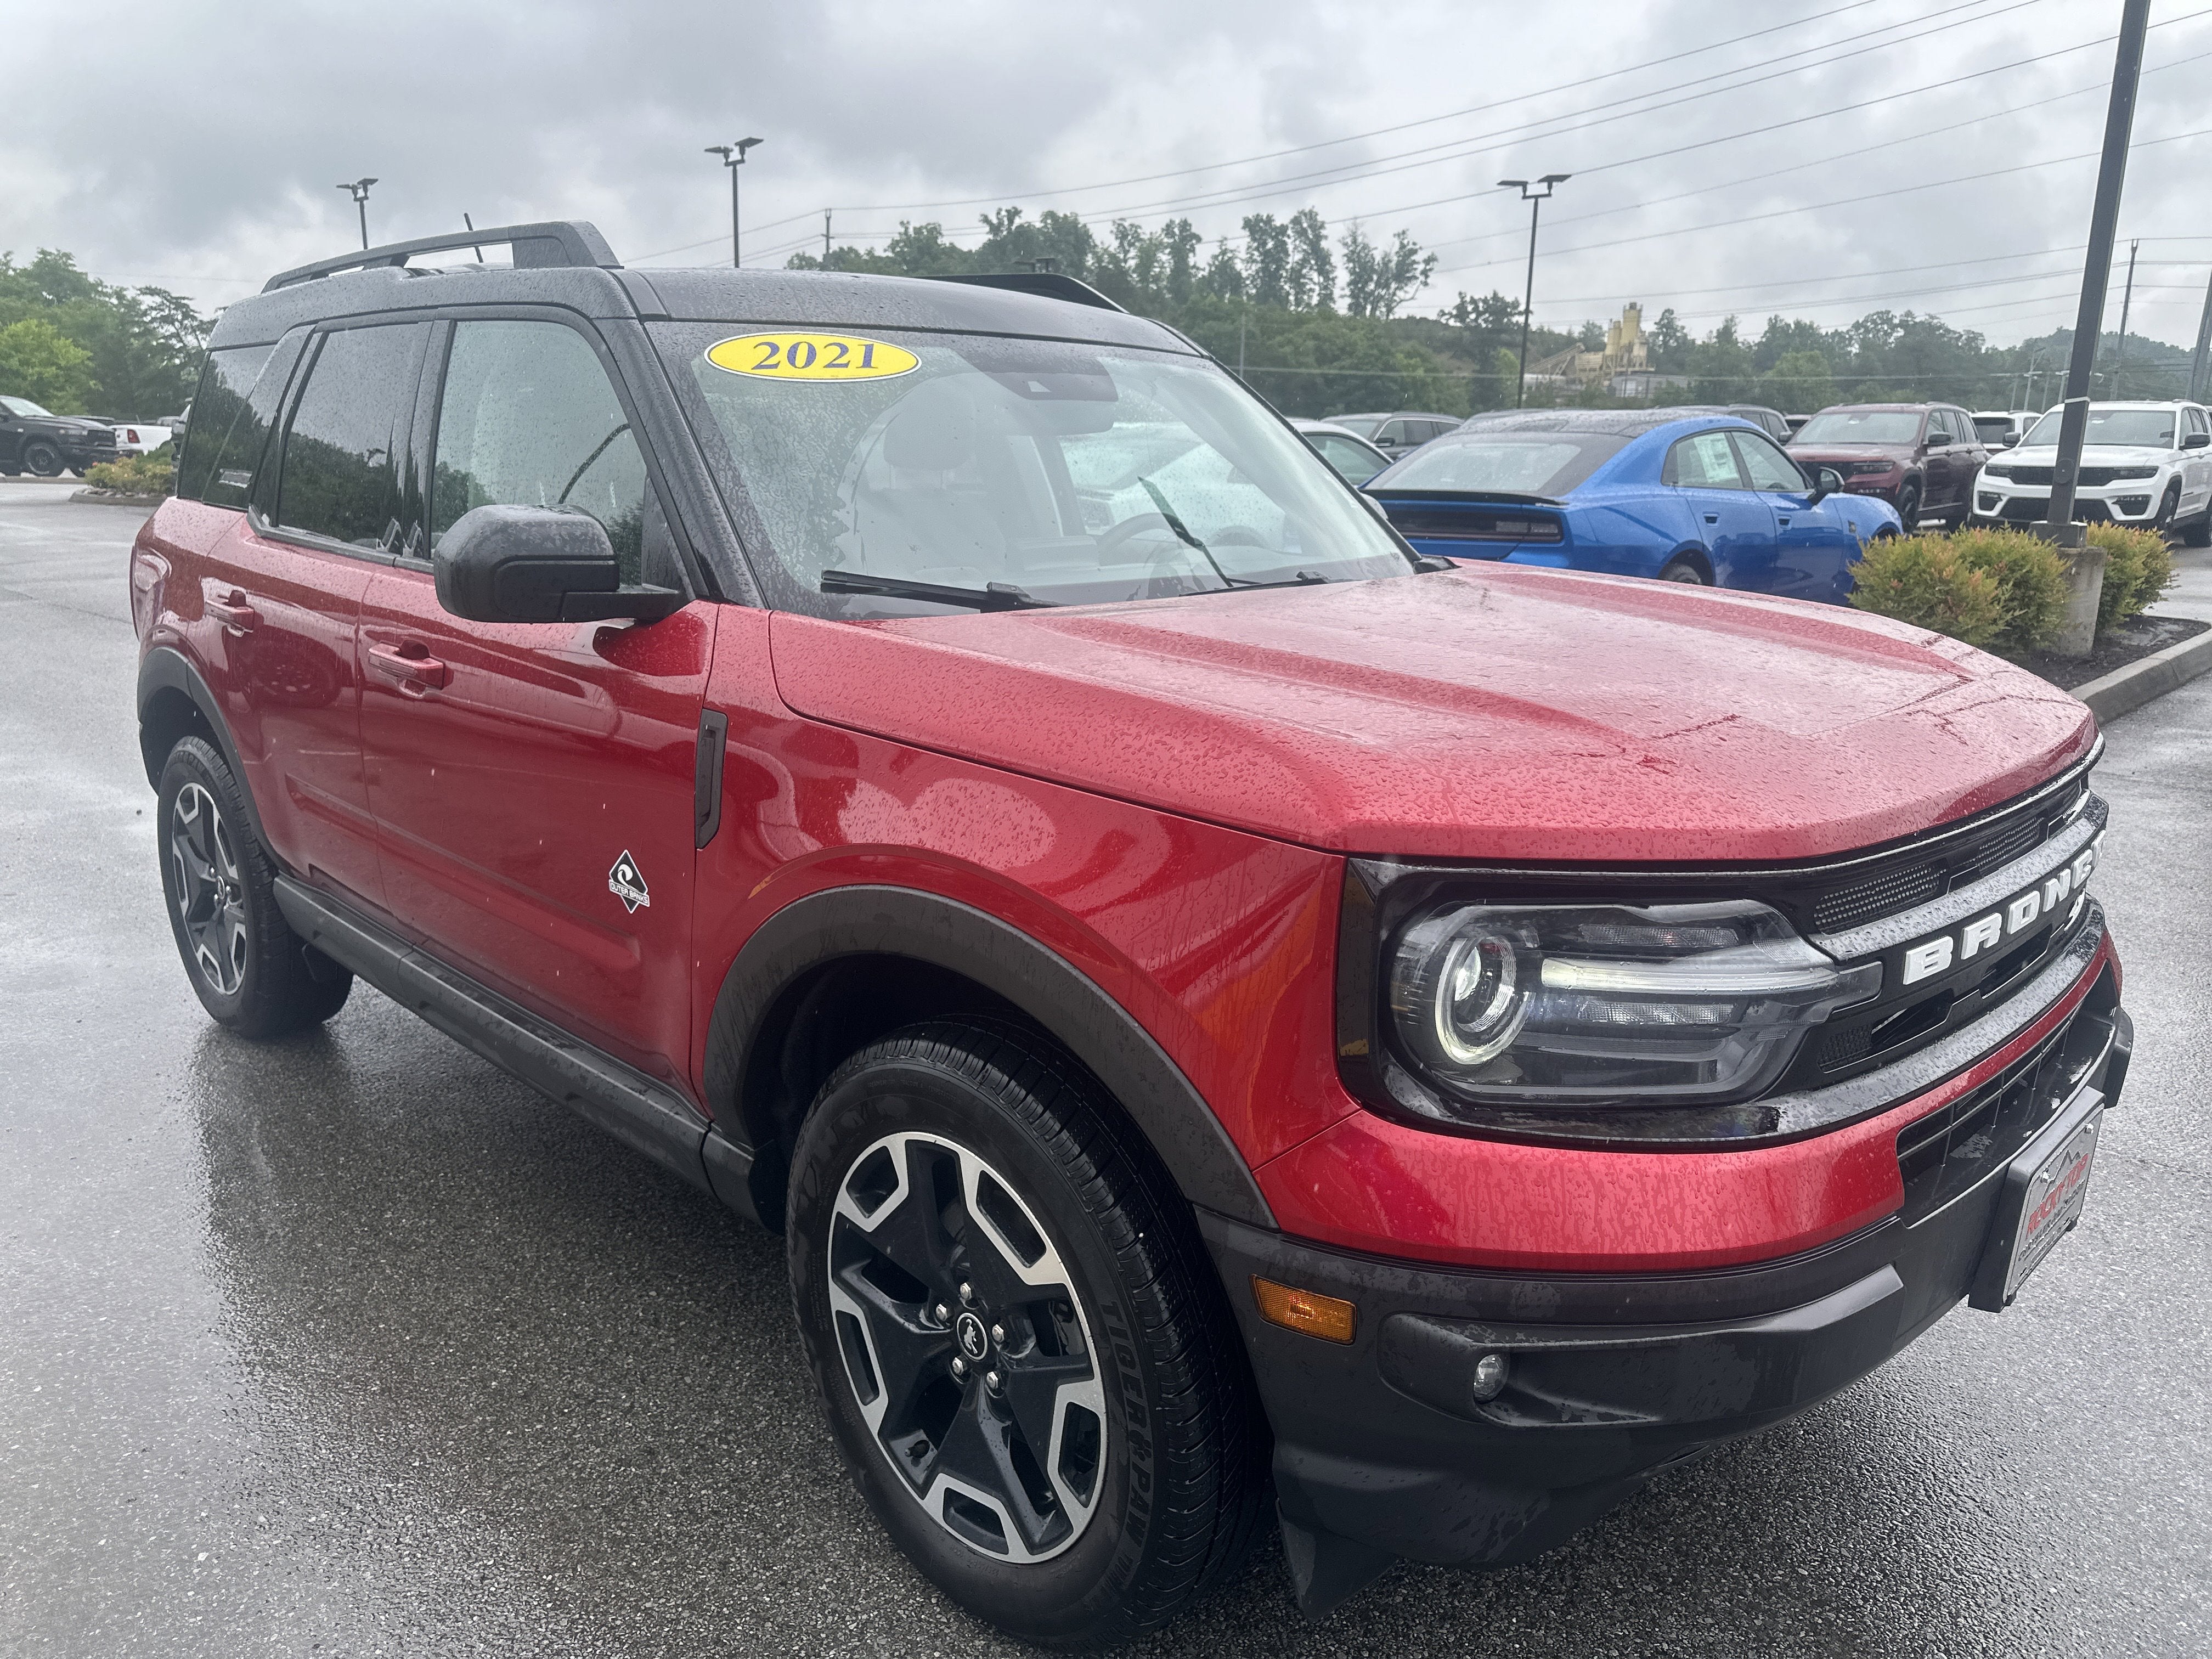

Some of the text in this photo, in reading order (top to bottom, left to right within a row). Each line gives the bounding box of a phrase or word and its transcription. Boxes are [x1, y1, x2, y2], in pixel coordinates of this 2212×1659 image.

[751, 341, 878, 370] 2021
[611, 883, 648, 904] OUTER BANKS
[1100, 1301, 1151, 1547] TIGER PAW
